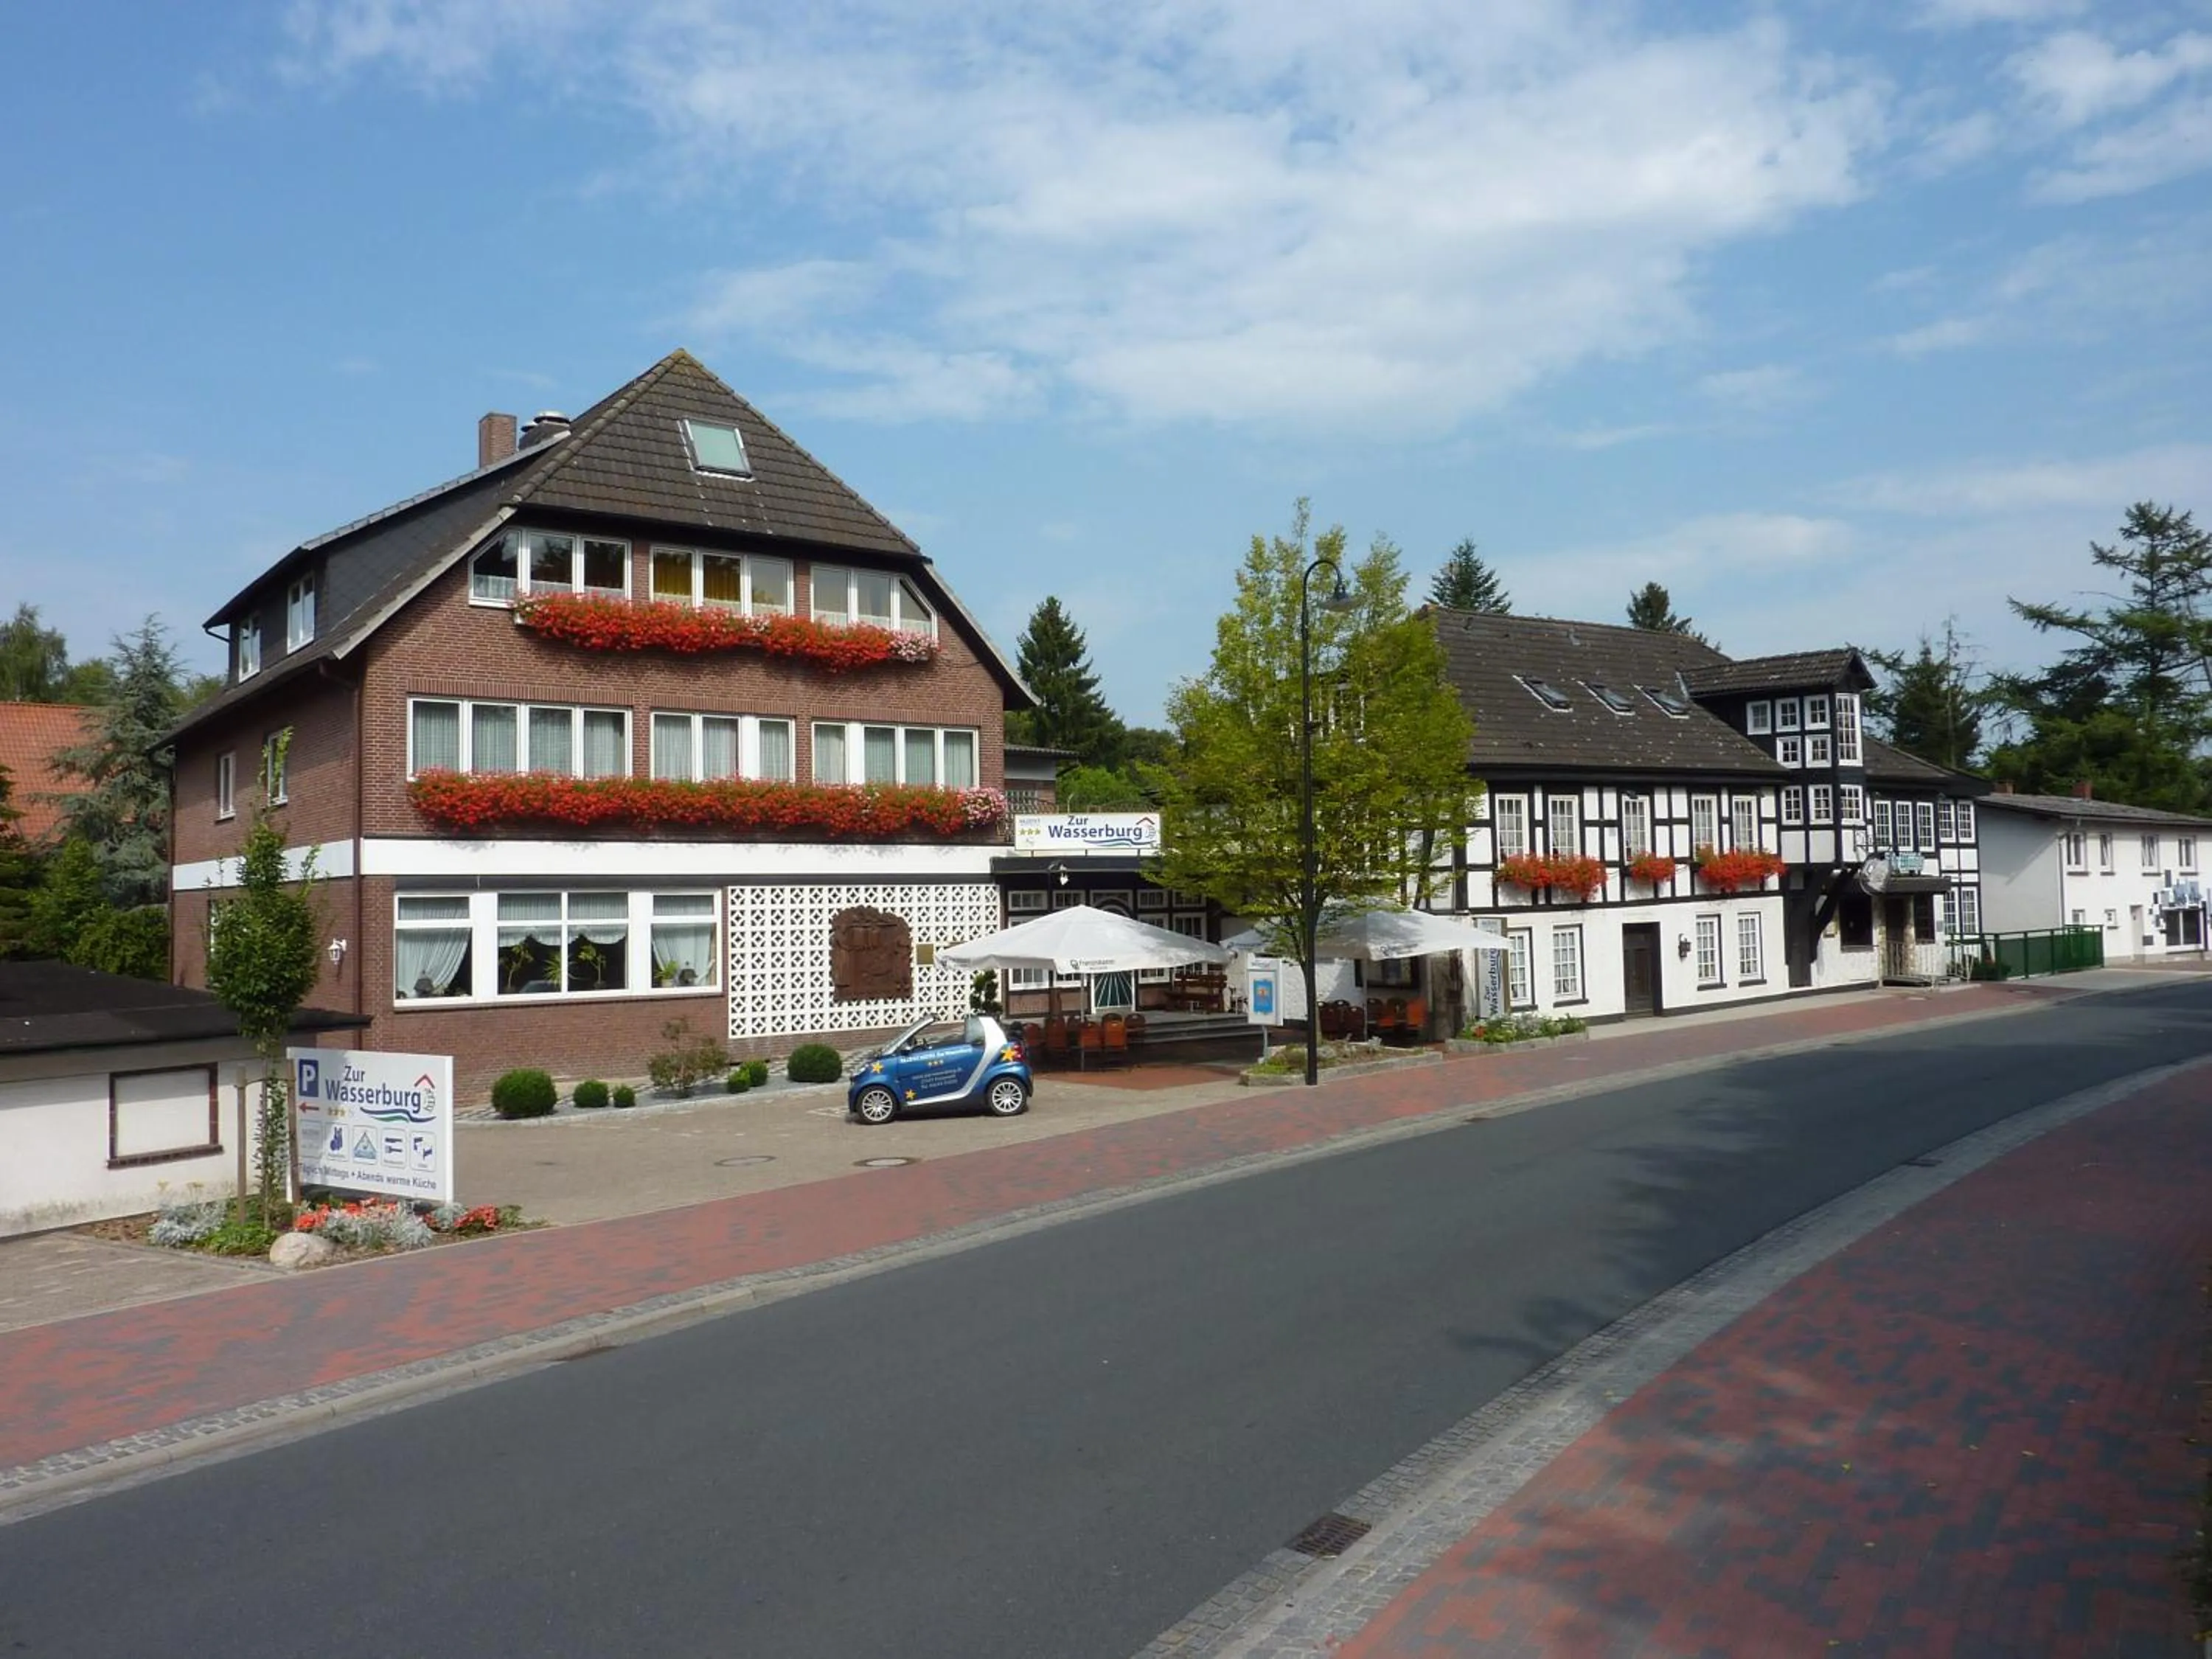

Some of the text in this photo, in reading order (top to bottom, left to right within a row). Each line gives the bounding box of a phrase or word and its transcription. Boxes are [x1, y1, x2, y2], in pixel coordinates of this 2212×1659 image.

[1068, 815, 1089, 826] Zur
[1048, 824, 1142, 840] Wasserburg
[302, 1064, 316, 1092] P
[344, 1065, 366, 1082] Zur
[325, 1079, 421, 1113] Wasserburg
[356, 1169, 384, 1183] Abends
[386, 1175, 411, 1186] warme
[413, 1176, 437, 1190] Küche
